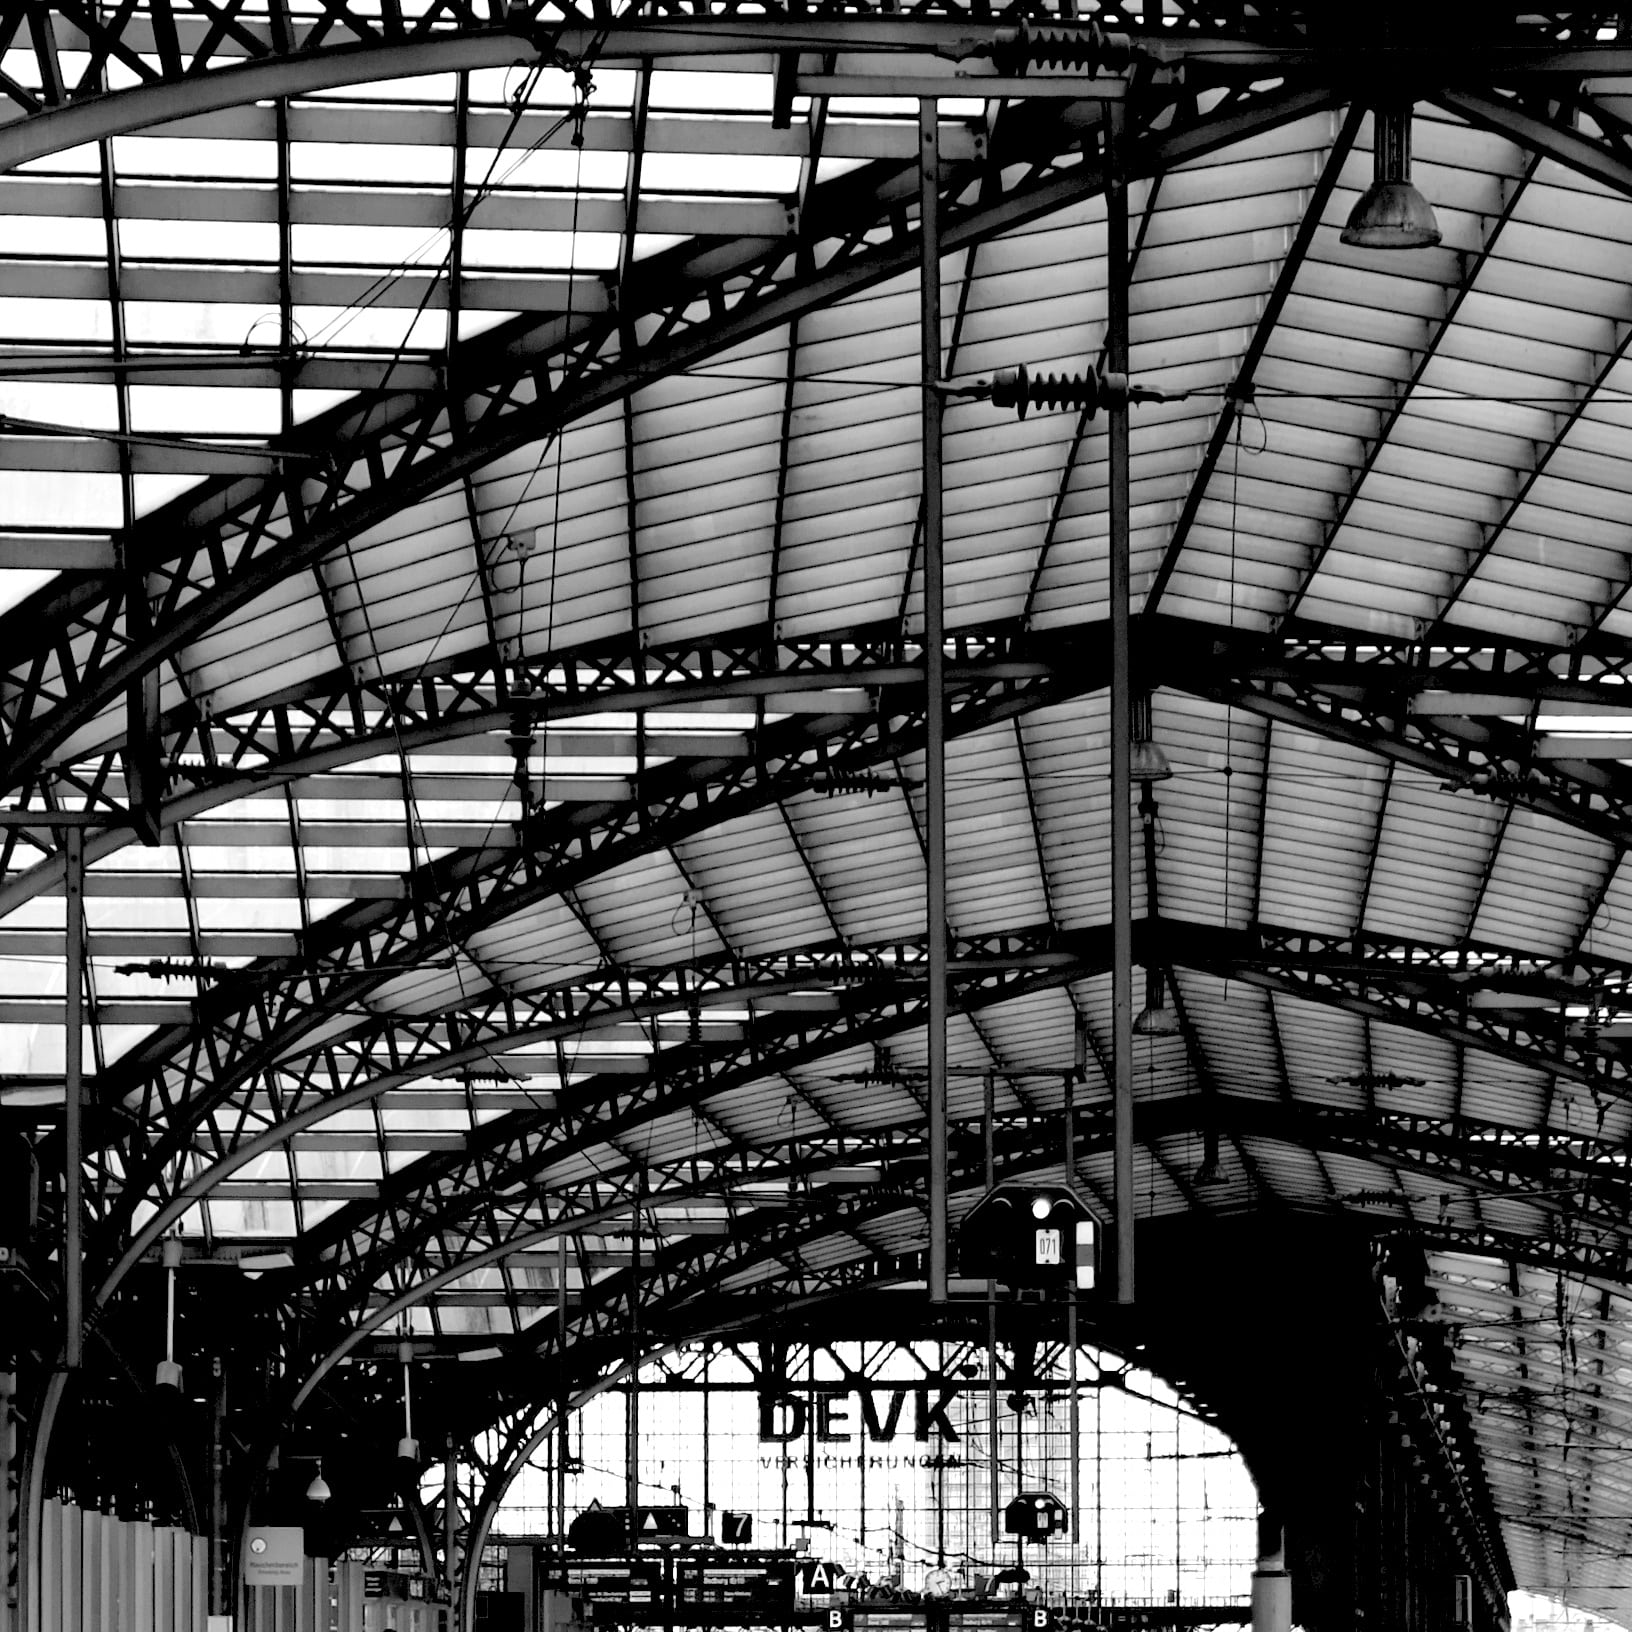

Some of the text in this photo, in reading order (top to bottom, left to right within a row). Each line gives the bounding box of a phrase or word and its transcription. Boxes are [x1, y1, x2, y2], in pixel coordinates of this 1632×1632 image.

[1039, 1238, 1056, 1255] 071
[758, 1390, 961, 1442] DEVK
[760, 1455, 961, 1469] VERSICHERUNGN
[732, 1513, 749, 1537] 7
[811, 1565, 830, 1588] A
[829, 1611, 842, 1628] B
[1034, 1610, 1047, 1627] B
